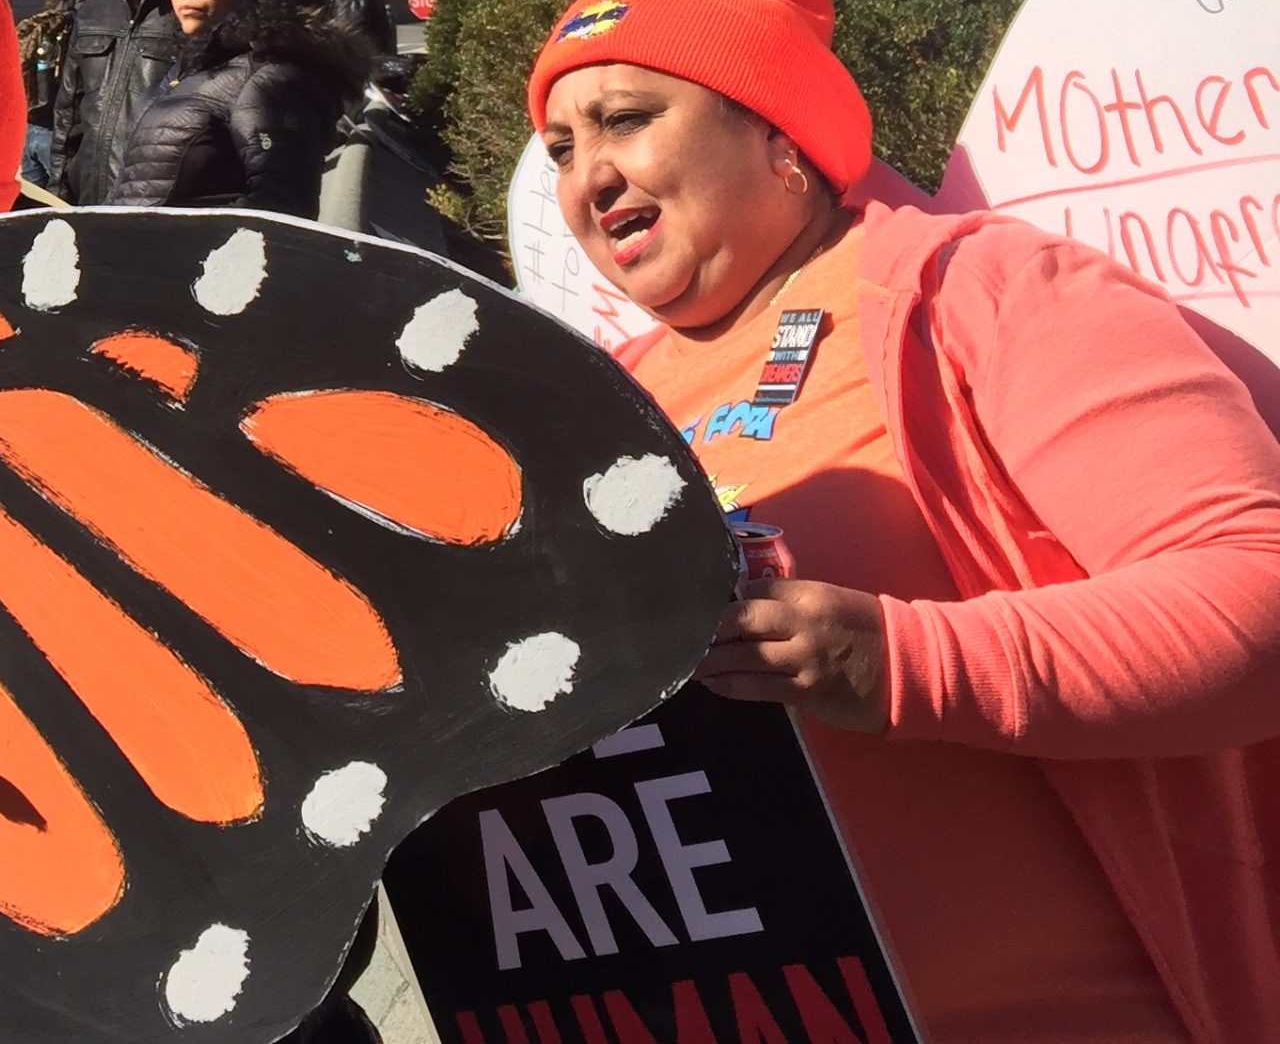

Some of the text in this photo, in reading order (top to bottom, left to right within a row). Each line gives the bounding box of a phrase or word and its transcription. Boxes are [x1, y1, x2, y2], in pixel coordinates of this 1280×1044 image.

[1064, 194, 1280, 308] nafr
[771, 324, 818, 349] STAND
[478, 770, 764, 970] ARE
